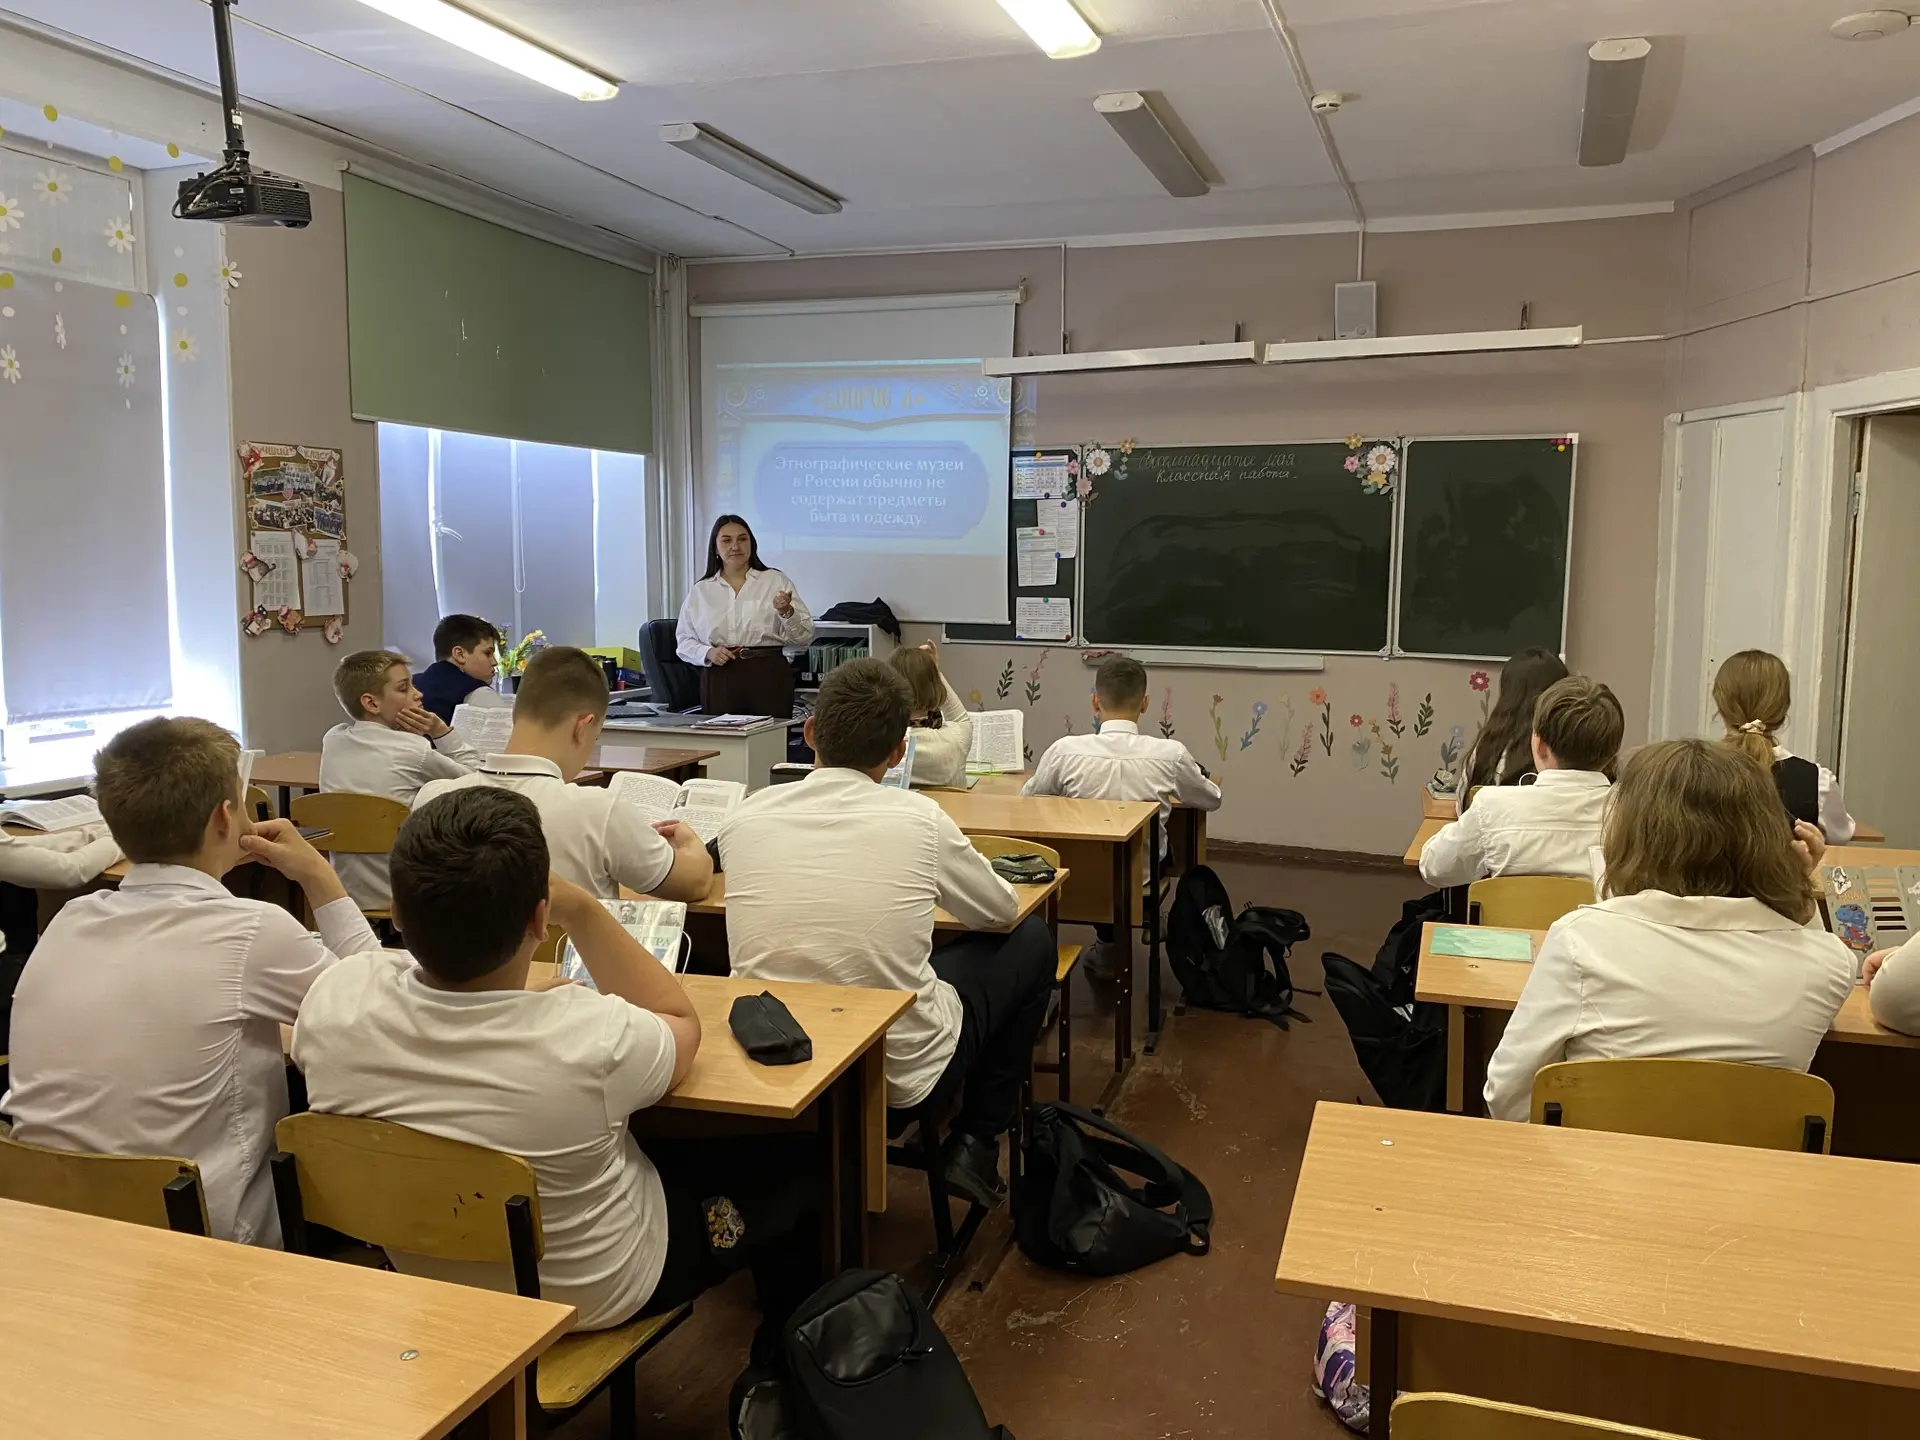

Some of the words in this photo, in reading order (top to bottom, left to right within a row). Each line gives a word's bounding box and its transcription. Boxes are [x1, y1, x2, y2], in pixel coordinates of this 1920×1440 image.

[775, 454, 913, 473] Этнографические
[916, 458, 964, 473] музеи
[793, 477, 801, 487] в
[805, 474, 860, 488] России
[863, 473, 922, 489] обычно
[926, 477, 946, 488] не
[1156, 466, 1231, 483] Классная
[790, 494, 864, 509] содержат
[868, 494, 946, 509] предметы
[810, 509, 847, 523] быта
[851, 512, 860, 523] и
[864, 512, 928, 528] одежду.
